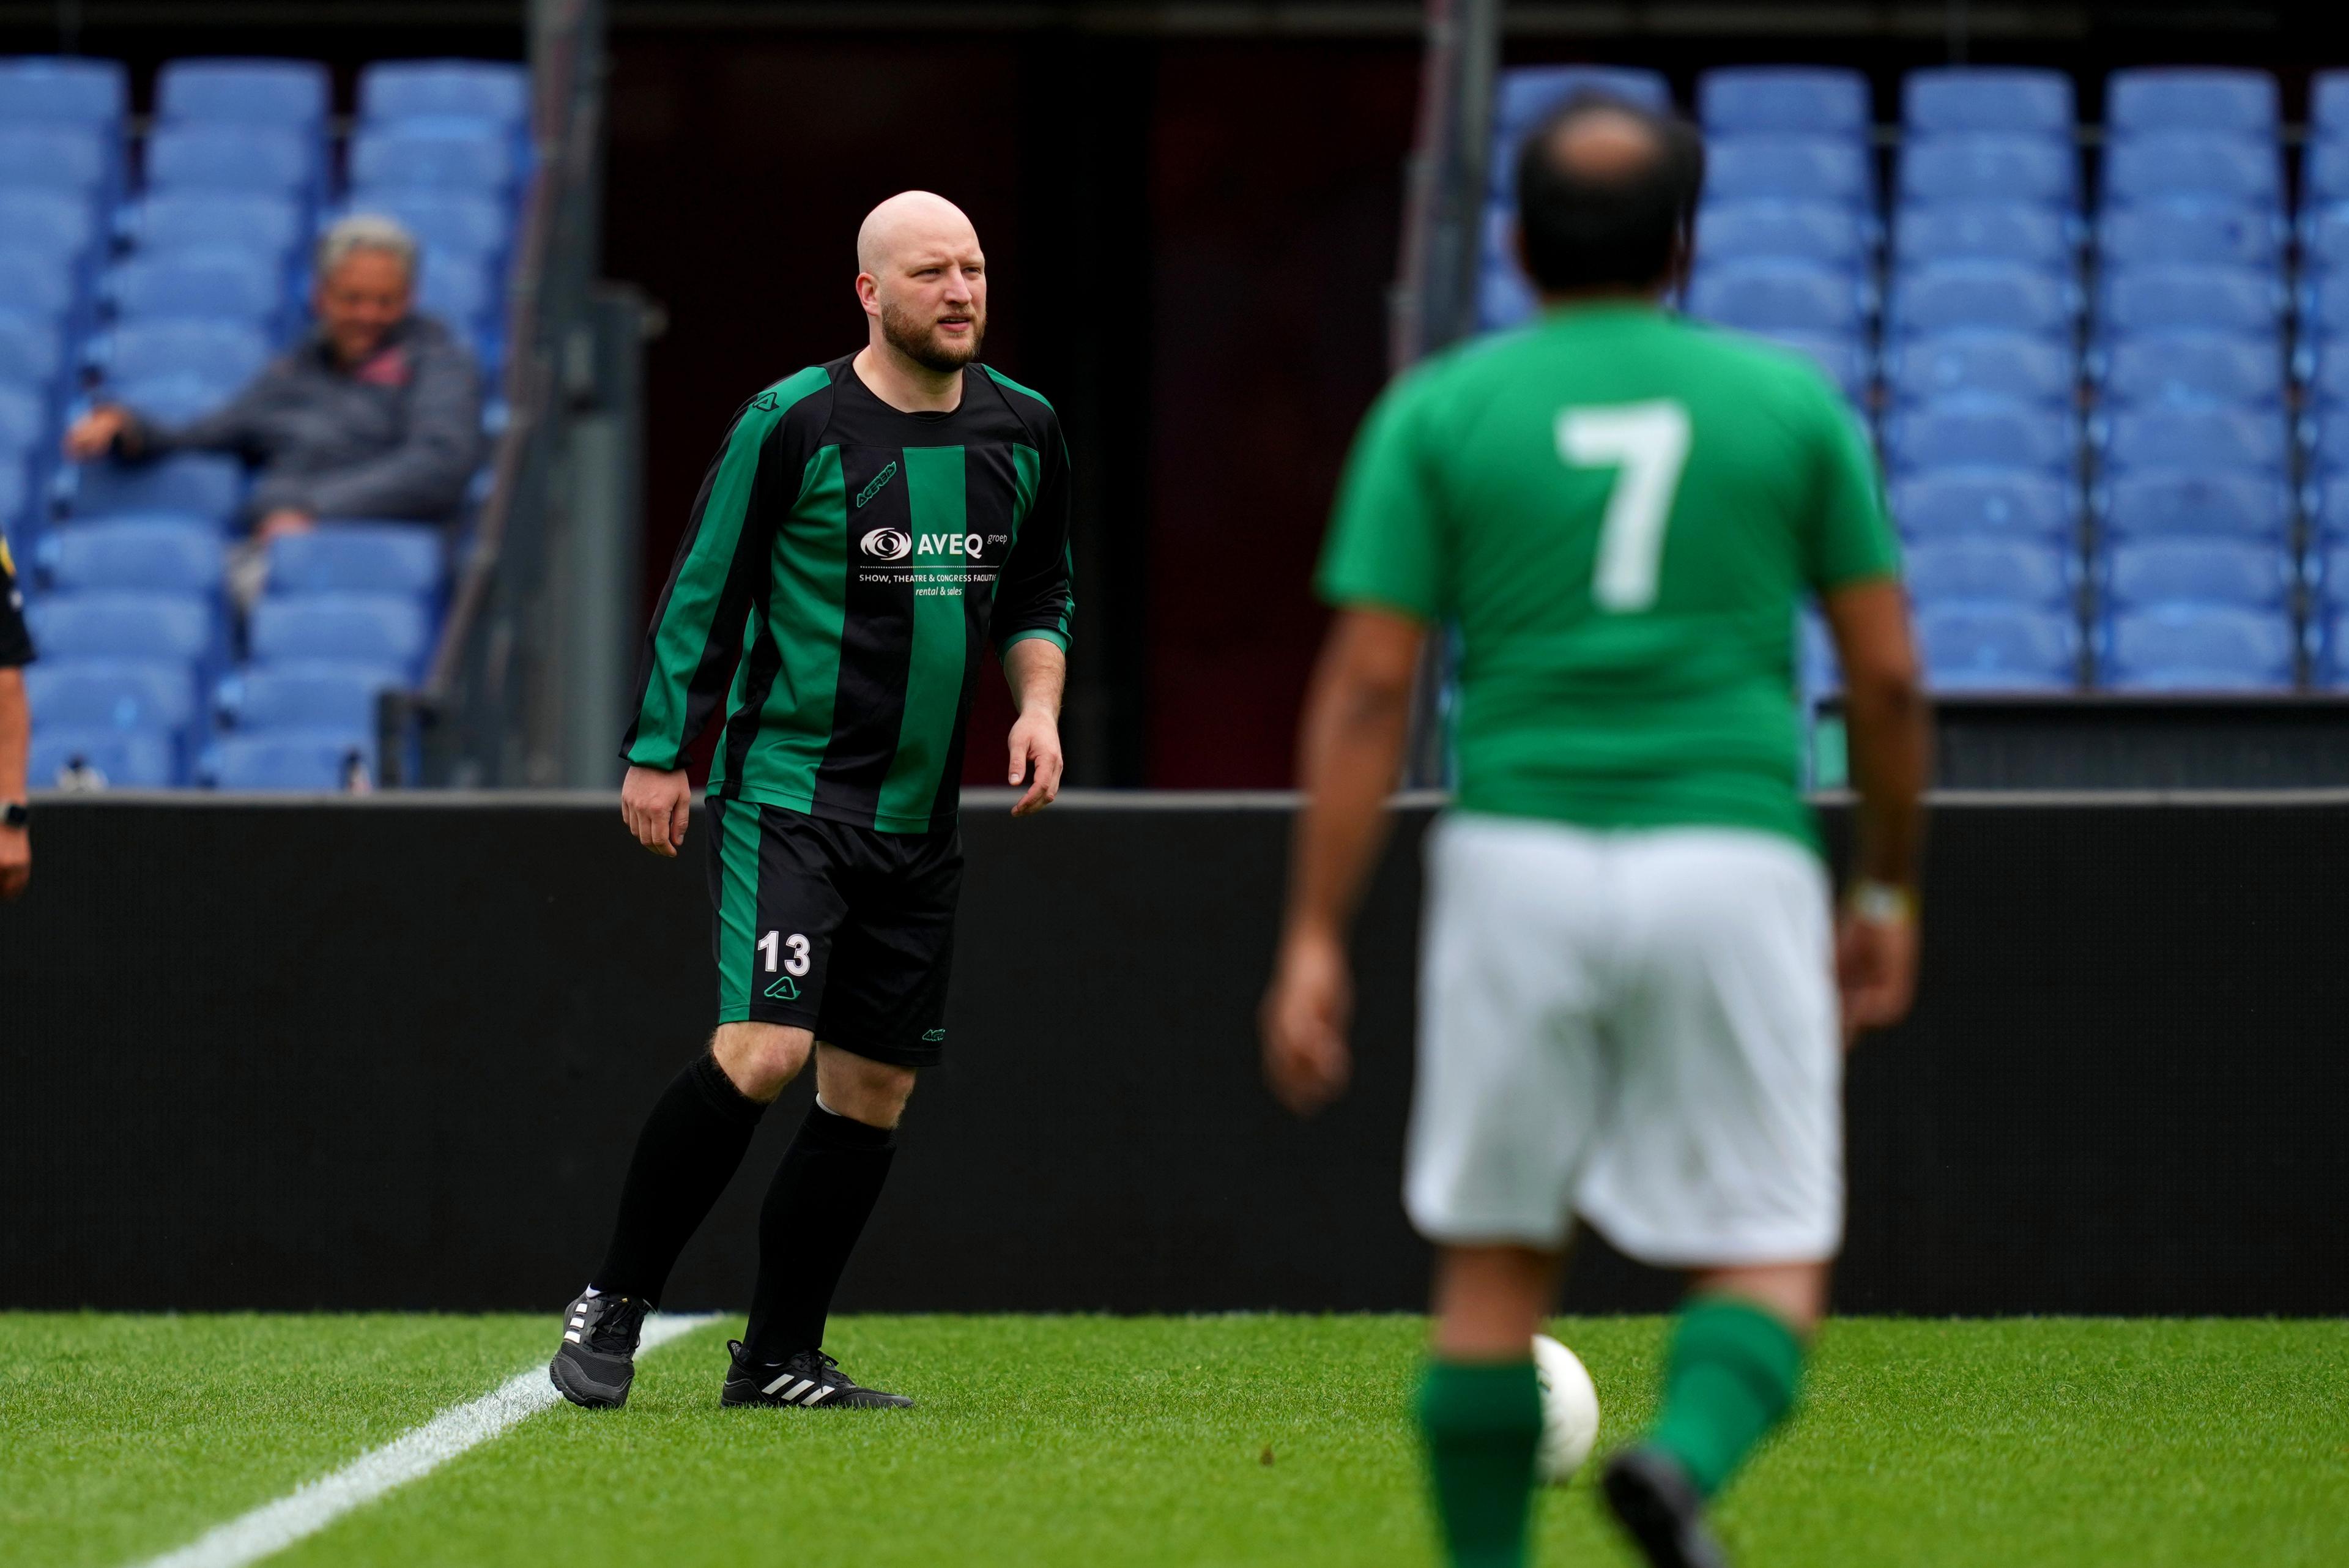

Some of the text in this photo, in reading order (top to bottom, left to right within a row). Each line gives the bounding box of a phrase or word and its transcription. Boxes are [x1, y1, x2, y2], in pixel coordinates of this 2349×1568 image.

[1554, 398, 1693, 612] 7
[918, 533, 1008, 559] AVEQ groep
[859, 574, 891, 584] SHOW,
[929, 574, 935, 582] &
[937, 574, 971, 582] CONGRESS
[915, 587, 962, 596] rental & sales
[757, 931, 811, 976] 13
